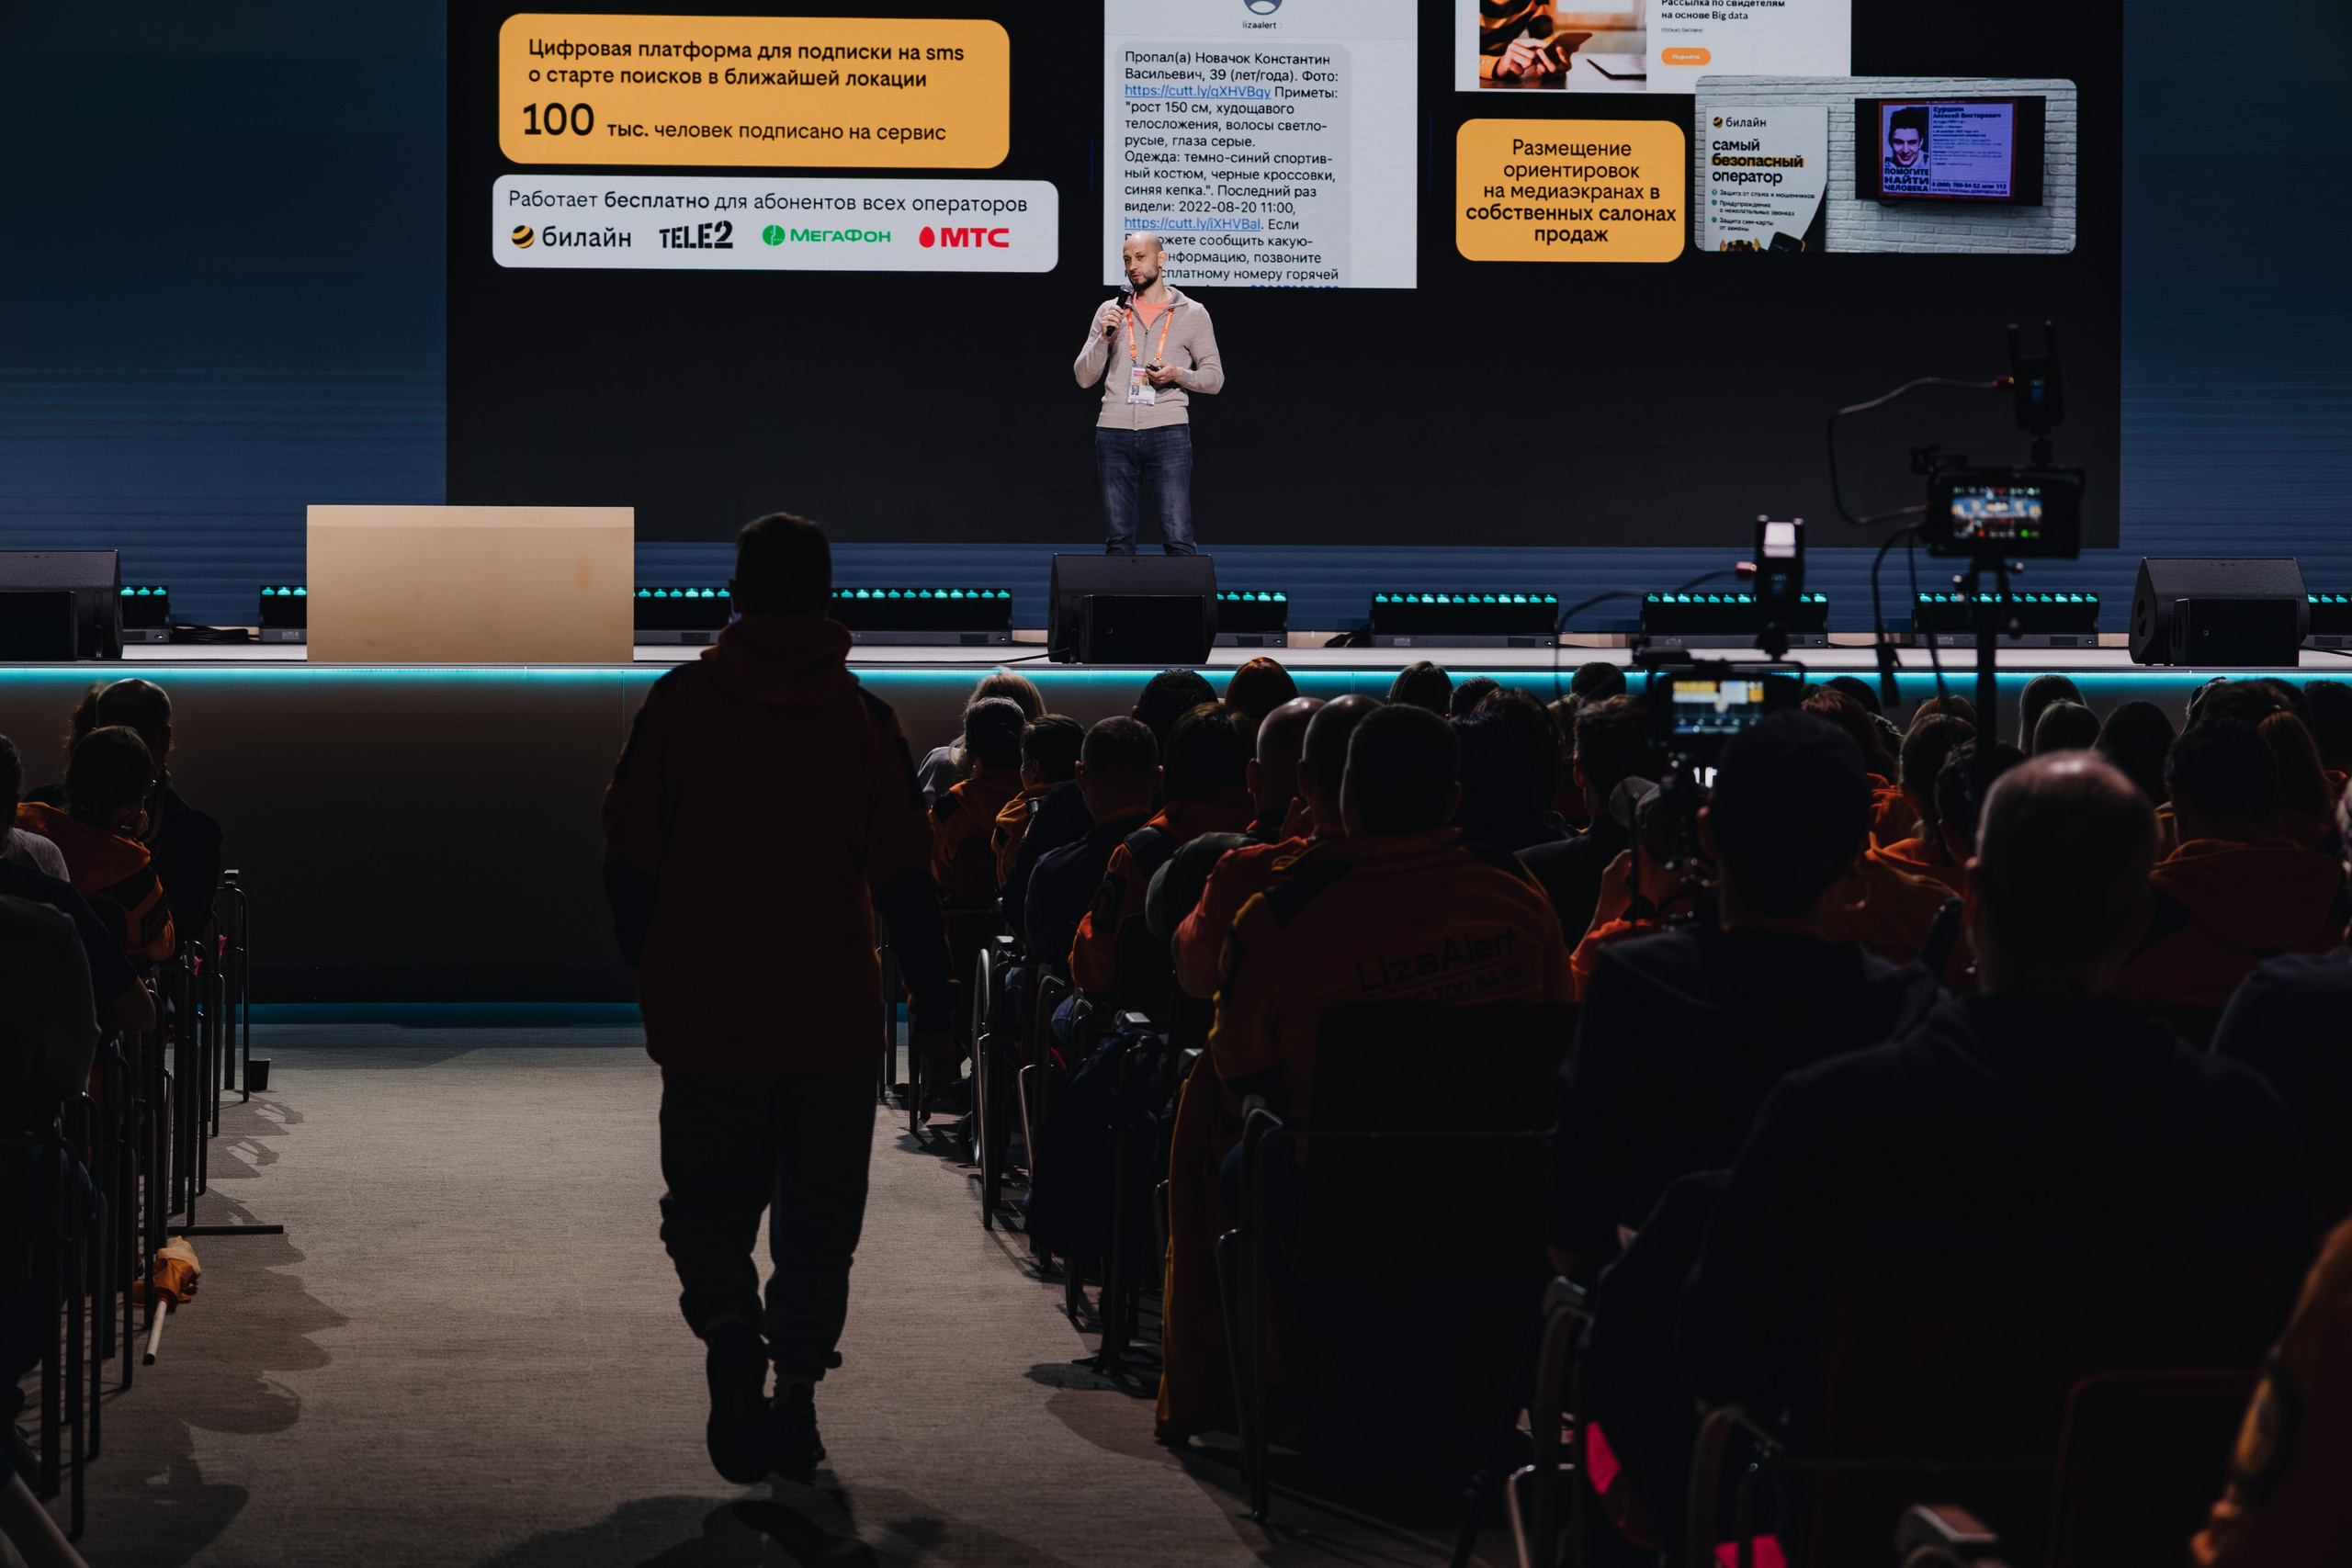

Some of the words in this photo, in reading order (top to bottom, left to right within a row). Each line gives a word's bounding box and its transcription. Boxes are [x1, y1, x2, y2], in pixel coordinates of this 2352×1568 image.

[1712, 11, 1726, 21] Big
[1728, 11, 1748, 19] data
[1243, 21, 1276, 29] lizaalert
[529, 39, 631, 61] Цифровая
[639, 40, 752, 62] платформа
[757, 46, 791, 61] для
[798, 46, 891, 62] подписки
[899, 48, 921, 60] на
[926, 48, 964, 61] sms
[1125, 51, 1191, 65] Пропал(а)
[1195, 52, 1250, 63] Новачок
[1255, 53, 1329, 64] Константин
[528, 70, 540, 82] о
[547, 70, 615, 87] старте
[621, 71, 702, 84] поисков
[708, 72, 718, 85] в
[725, 67, 839, 85] ближайшей
[845, 73, 926, 89] локации
[1125, 68, 1204, 82] Васильевич,
[1210, 69, 1227, 80] 39
[1230, 69, 1297, 83] (лет/года).
[1302, 71, 1338, 82] Фото:
[1275, 86, 1338, 99] Приметы:
[1125, 101, 1161, 114] "рост
[1165, 101, 1188, 113] 150
[1192, 104, 1212, 115] см,
[1216, 105, 1295, 116] худощавого
[524, 102, 594, 136] 100
[607, 124, 649, 137] тыс.
[654, 125, 732, 138] человек
[740, 126, 843, 141] подписано
[850, 127, 871, 140] на
[876, 128, 946, 144] сервис
[1125, 120, 1221, 132] телосложения,
[1226, 121, 1273, 130] волосы
[1278, 122, 1327, 131] светло-
[1725, 117, 1767, 128] билайн
[1125, 137, 1168, 148] русые,
[1172, 137, 1207, 146] глаза
[1211, 138, 1255, 149] серые.
[1513, 139, 1632, 159] Размещение
[1713, 139, 1759, 151] самый
[1125, 150, 1180, 164] Одежда:
[1184, 152, 1270, 163] темно-синий
[1273, 154, 1332, 165] спортив-
[1712, 152, 1804, 167] безопасный
[1125, 167, 1150, 178] ный
[1154, 170, 1206, 181] костюм,
[1211, 171, 1260, 182] черные
[1264, 171, 1335, 183] кроссовки,
[1504, 164, 1640, 182] ориентировок
[1712, 171, 1782, 186] оператор
[1884, 175, 1928, 185] НАЙТИ
[1125, 186, 1161, 195] синяя
[1217, 185, 1290, 198] Последний
[1295, 188, 1317, 198] раз
[1484, 186, 1505, 198] на
[1511, 186, 1644, 203] медиаэкранах
[1650, 187, 1660, 199] в
[510, 190, 598, 208] Работает
[605, 191, 709, 209] бесплатно
[714, 197, 747, 211] для
[754, 193, 856, 210] абонентов
[864, 198, 906, 210] всех
[912, 198, 1027, 216] операторов
[1125, 203, 1174, 213] видели:
[1179, 200, 1257, 213] 2022-08-20
[1261, 202, 1295, 215] 11:00,
[1466, 203, 1593, 220] собственных
[1599, 209, 1676, 221] салонах
[1268, 219, 1299, 230] Если
[542, 225, 631, 247] билайн
[659, 220, 733, 249] TELE2
[941, 228, 1009, 248] МТС
[1159, 236, 1196, 245] ожете
[1199, 234, 1264, 247] сообщить
[1268, 238, 1313, 249] какую-
[1535, 229, 1608, 246] продаж
[1168, 251, 1250, 265] нформацию,
[1254, 254, 1321, 264] позвоните
[1162, 269, 1230, 281] сплатному
[1234, 270, 1283, 282] номеру
[1286, 268, 1339, 282] горячей
[1356, 927, 1516, 992] LizaAlert
[1431, 979, 1473, 1003] 700
